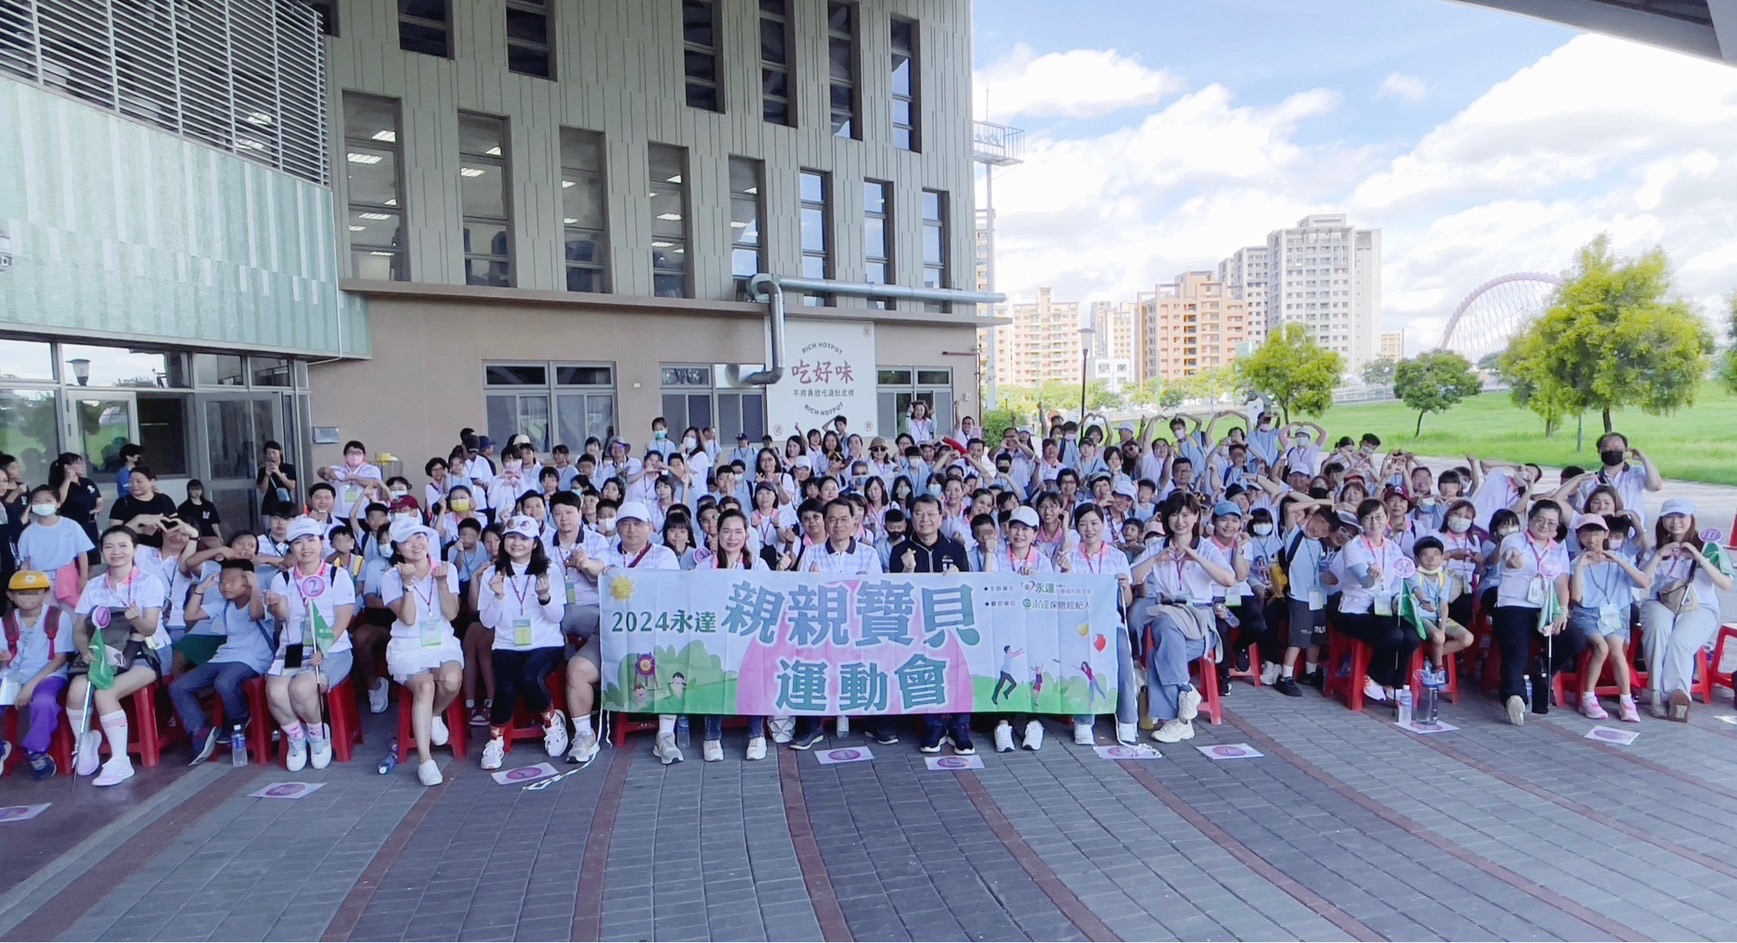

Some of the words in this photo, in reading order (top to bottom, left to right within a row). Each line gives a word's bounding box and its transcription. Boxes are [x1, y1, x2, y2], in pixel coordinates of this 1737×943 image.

[802, 342, 817, 354] RICH
[818, 342, 843, 355] HOTPOT
[791, 359, 854, 384] 吃好味
[804, 404, 819, 415] RICH
[820, 402, 844, 416] HOTPOT
[308, 579, 319, 593] 2
[612, 609, 716, 634] 2024永達
[721, 579, 981, 648] 親親寶貝
[777, 654, 948, 712] 運動會
